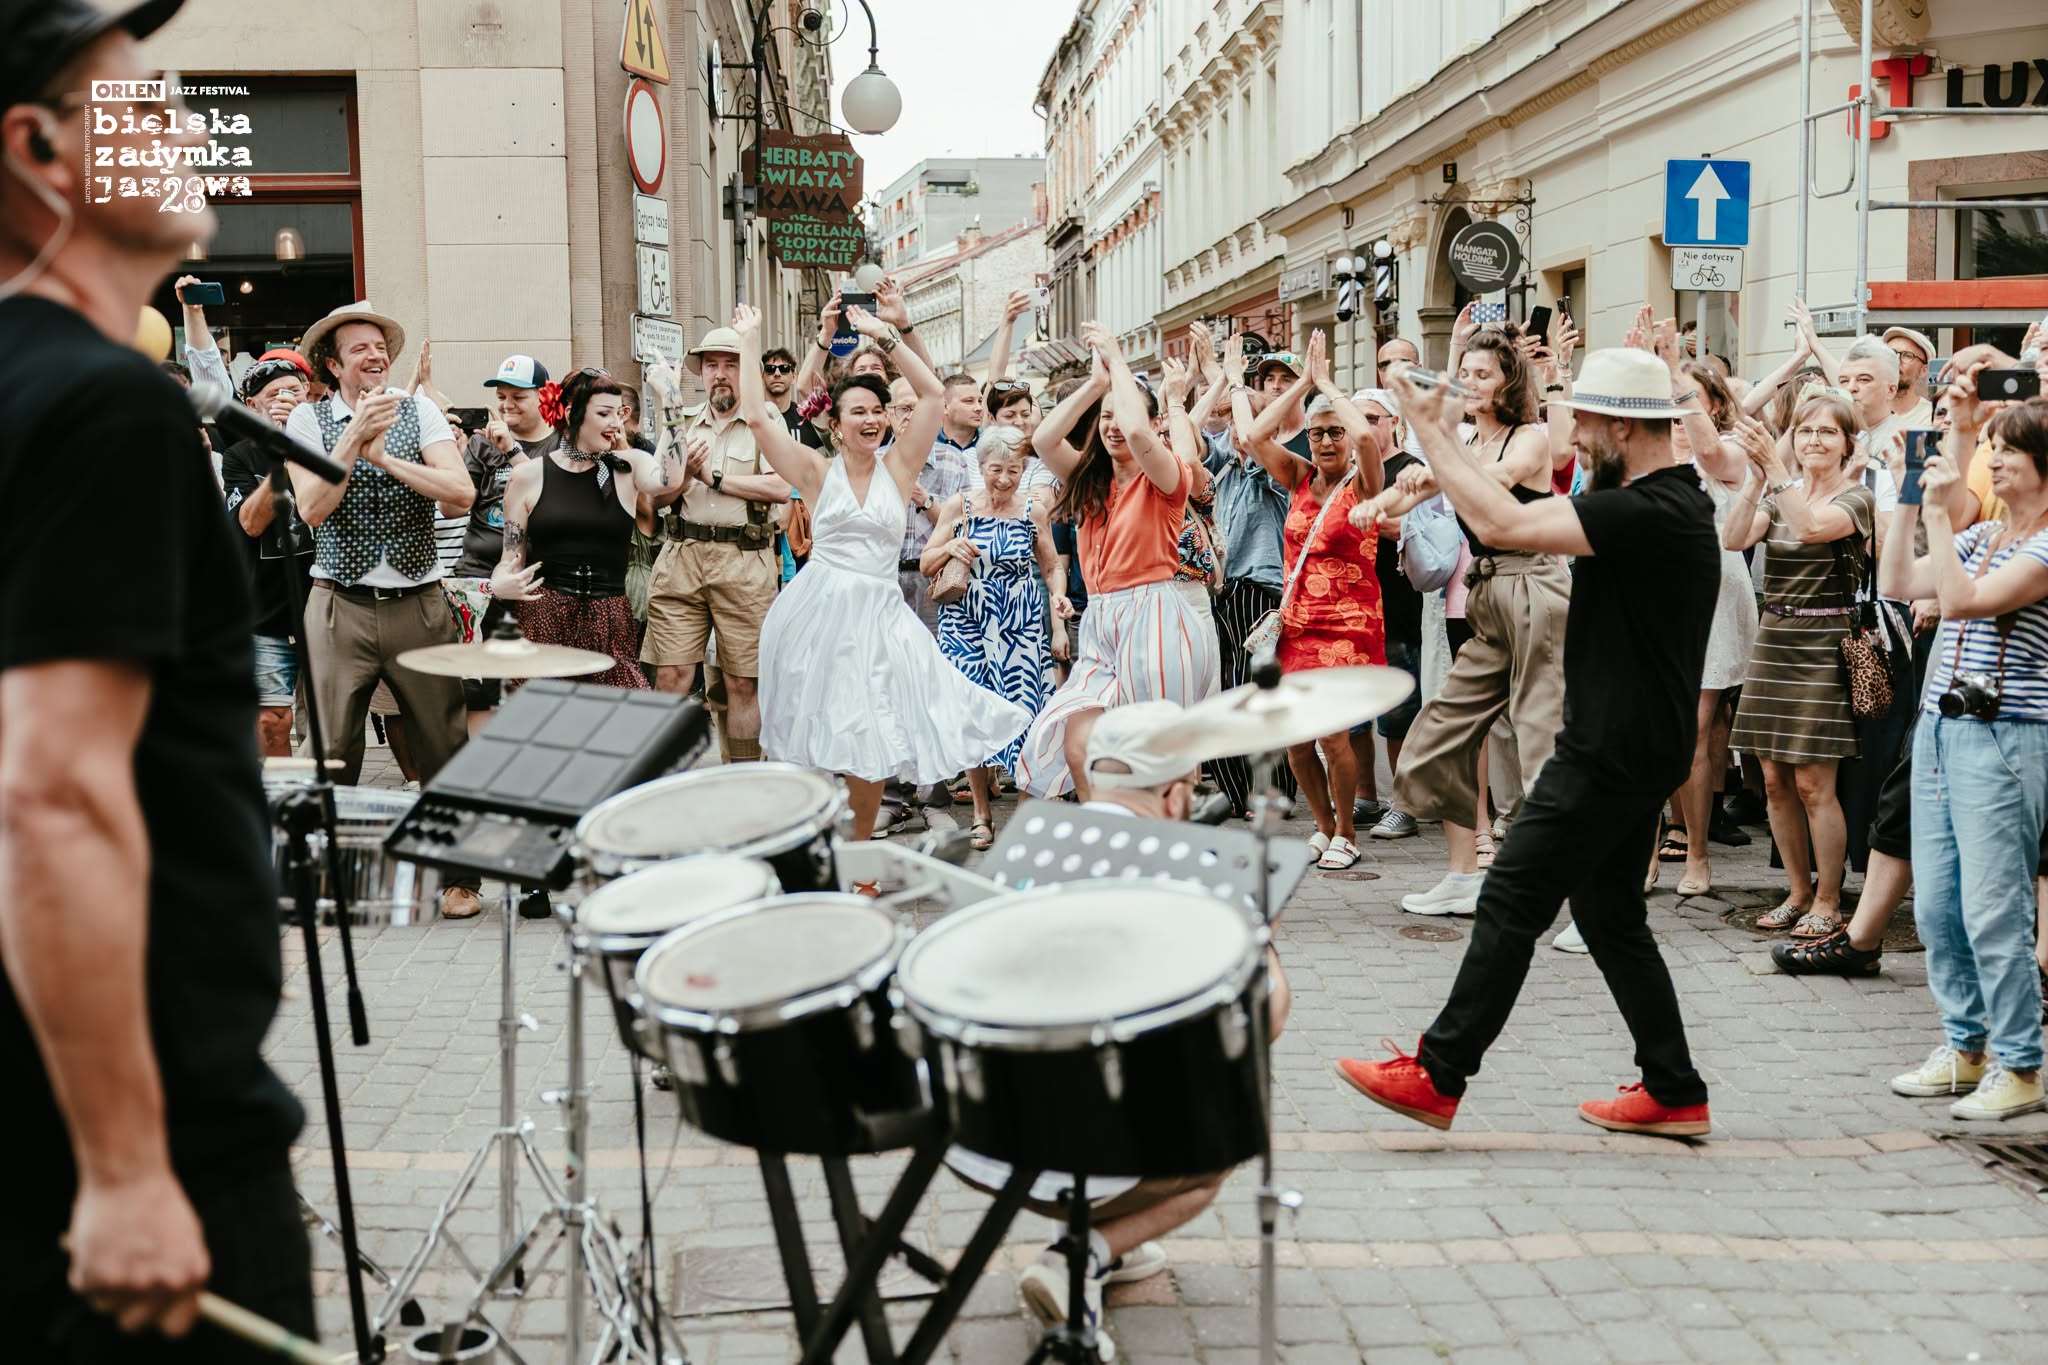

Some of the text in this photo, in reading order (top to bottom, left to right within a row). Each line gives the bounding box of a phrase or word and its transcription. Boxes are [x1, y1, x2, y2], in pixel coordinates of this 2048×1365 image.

[757, 187, 849, 214] KAWA
[771, 221, 864, 239] PORCELANA
[776, 236, 858, 253] SŁODYCZE
[1455, 242, 1498, 259] MANGATA
[782, 250, 853, 266] BAKALIE
[1453, 250, 1494, 265] HOLDING
[1683, 251, 1735, 263] Nie dotyczy
